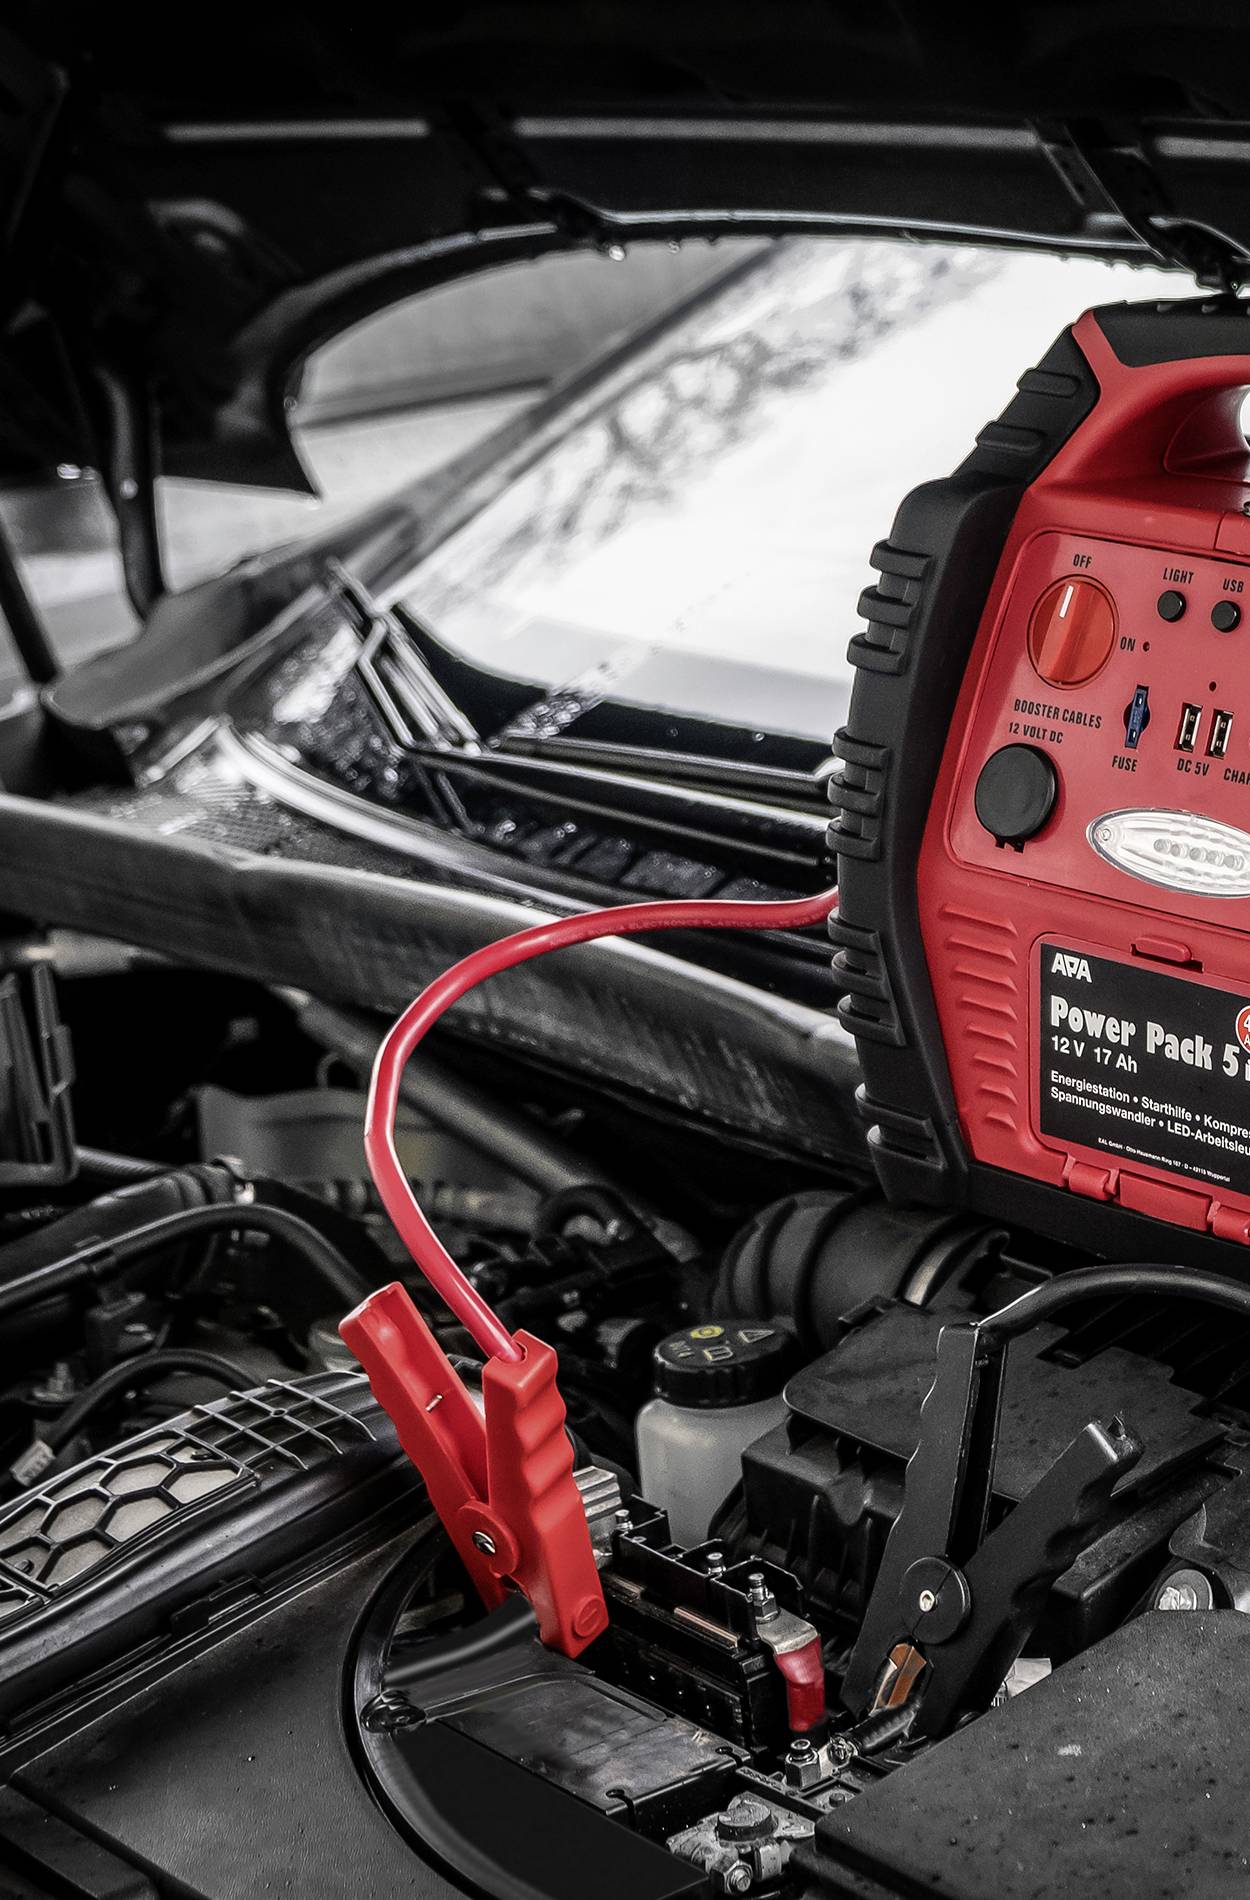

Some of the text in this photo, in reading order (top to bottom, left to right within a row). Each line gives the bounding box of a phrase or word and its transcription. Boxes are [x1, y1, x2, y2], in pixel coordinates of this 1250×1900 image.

[1072, 553, 1092, 569] OFF
[1163, 567, 1195, 585] LIGHT
[1222, 578, 1245, 593] USB
[1119, 636, 1136, 651] ON
[1014, 698, 1102, 729] BOOSTER CABLES
[1009, 722, 1064, 744] 12 VOLT DC
[1111, 755, 1138, 772] FUSE
[1176, 757, 1210, 776] DC 5V
[1050, 994, 1137, 1047] Power
[1146, 1020, 1213, 1071] Pack
[1221, 1043, 1241, 1078] 5
[1051, 1034, 1138, 1074] 12 V 17 Ah
[1050, 1070, 1131, 1104] Energiestation
[1141, 1095, 1193, 1122] Starthilfe
[1050, 1086, 1157, 1127] Spannungswandler
